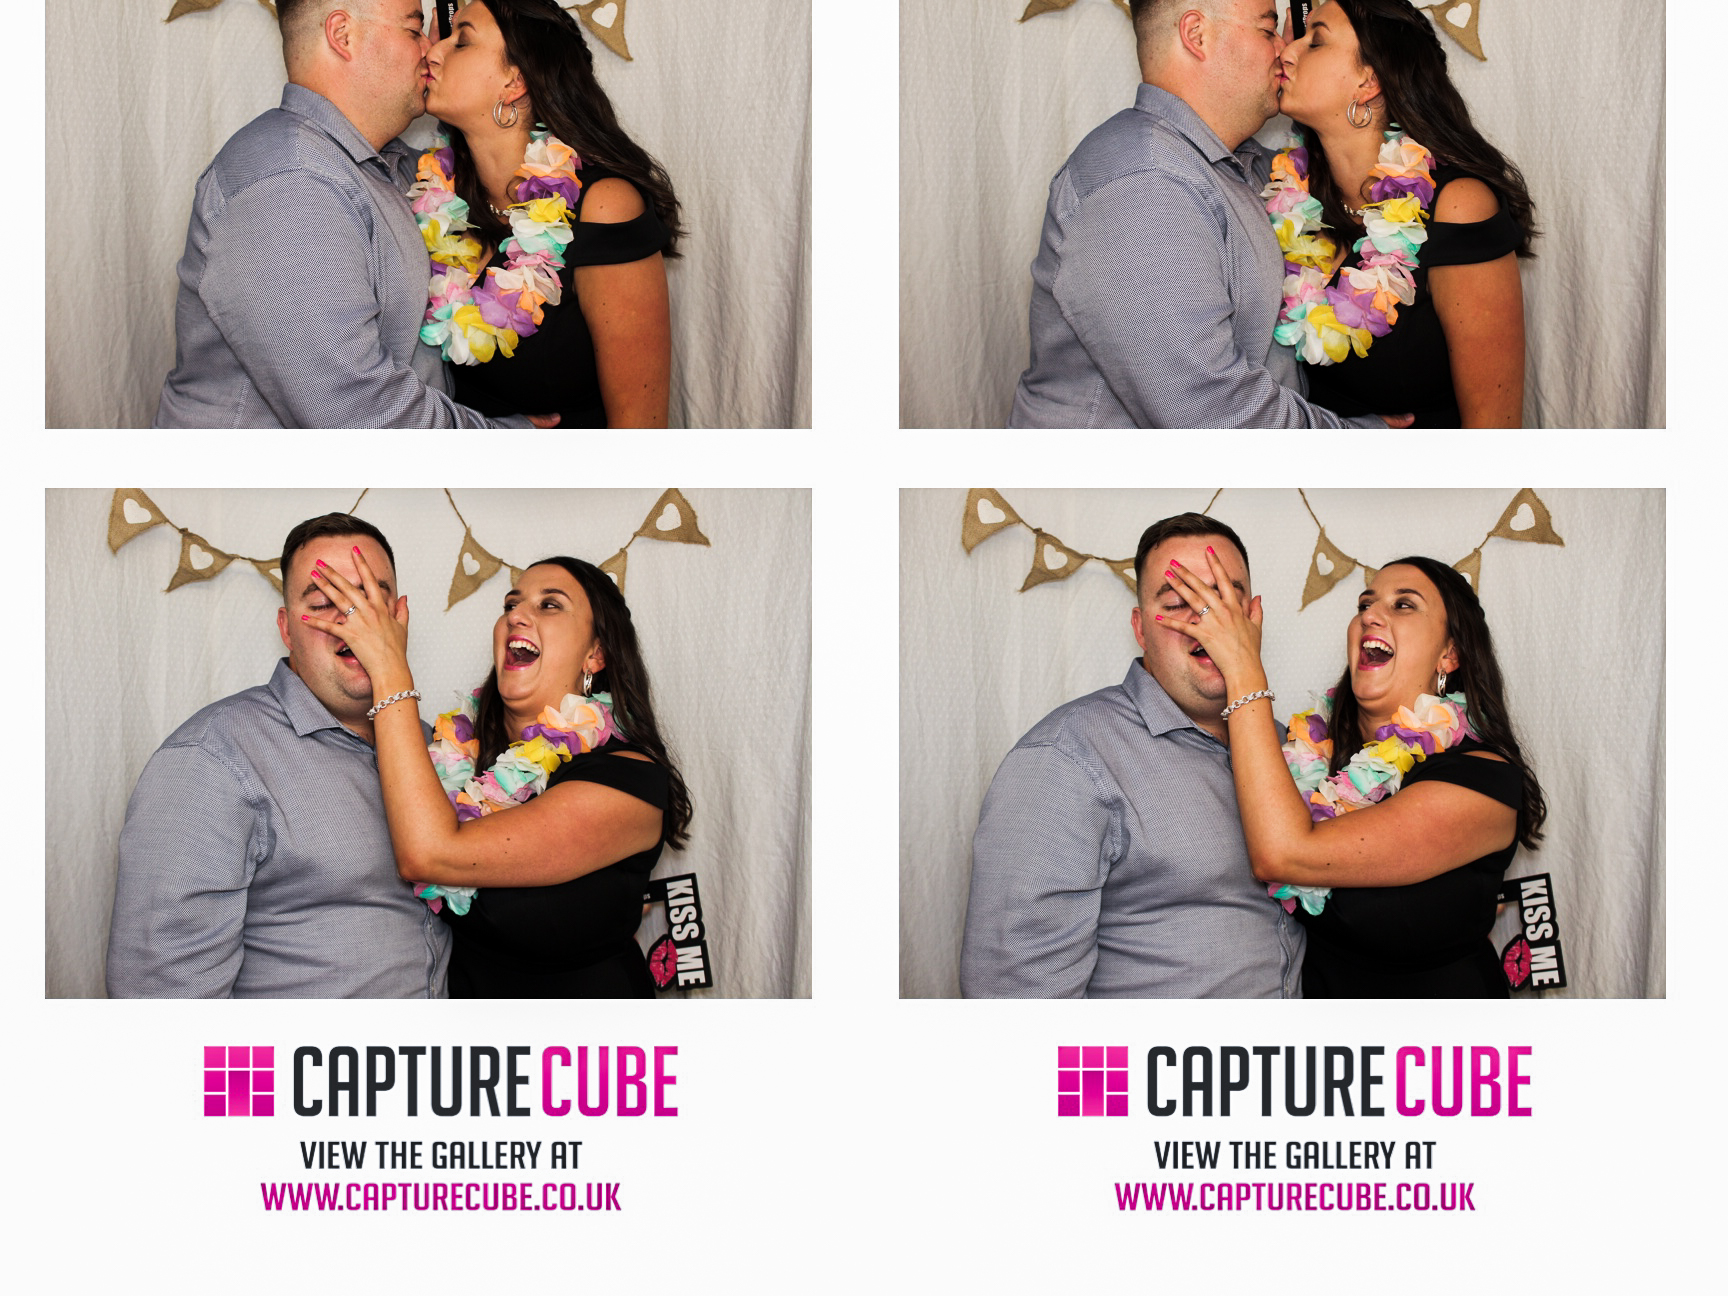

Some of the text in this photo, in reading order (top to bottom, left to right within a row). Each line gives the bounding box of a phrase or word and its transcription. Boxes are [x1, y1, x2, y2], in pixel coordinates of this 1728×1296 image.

[666, 878, 706, 986] KISS ME
[1520, 878, 1560, 986] KISS ME
